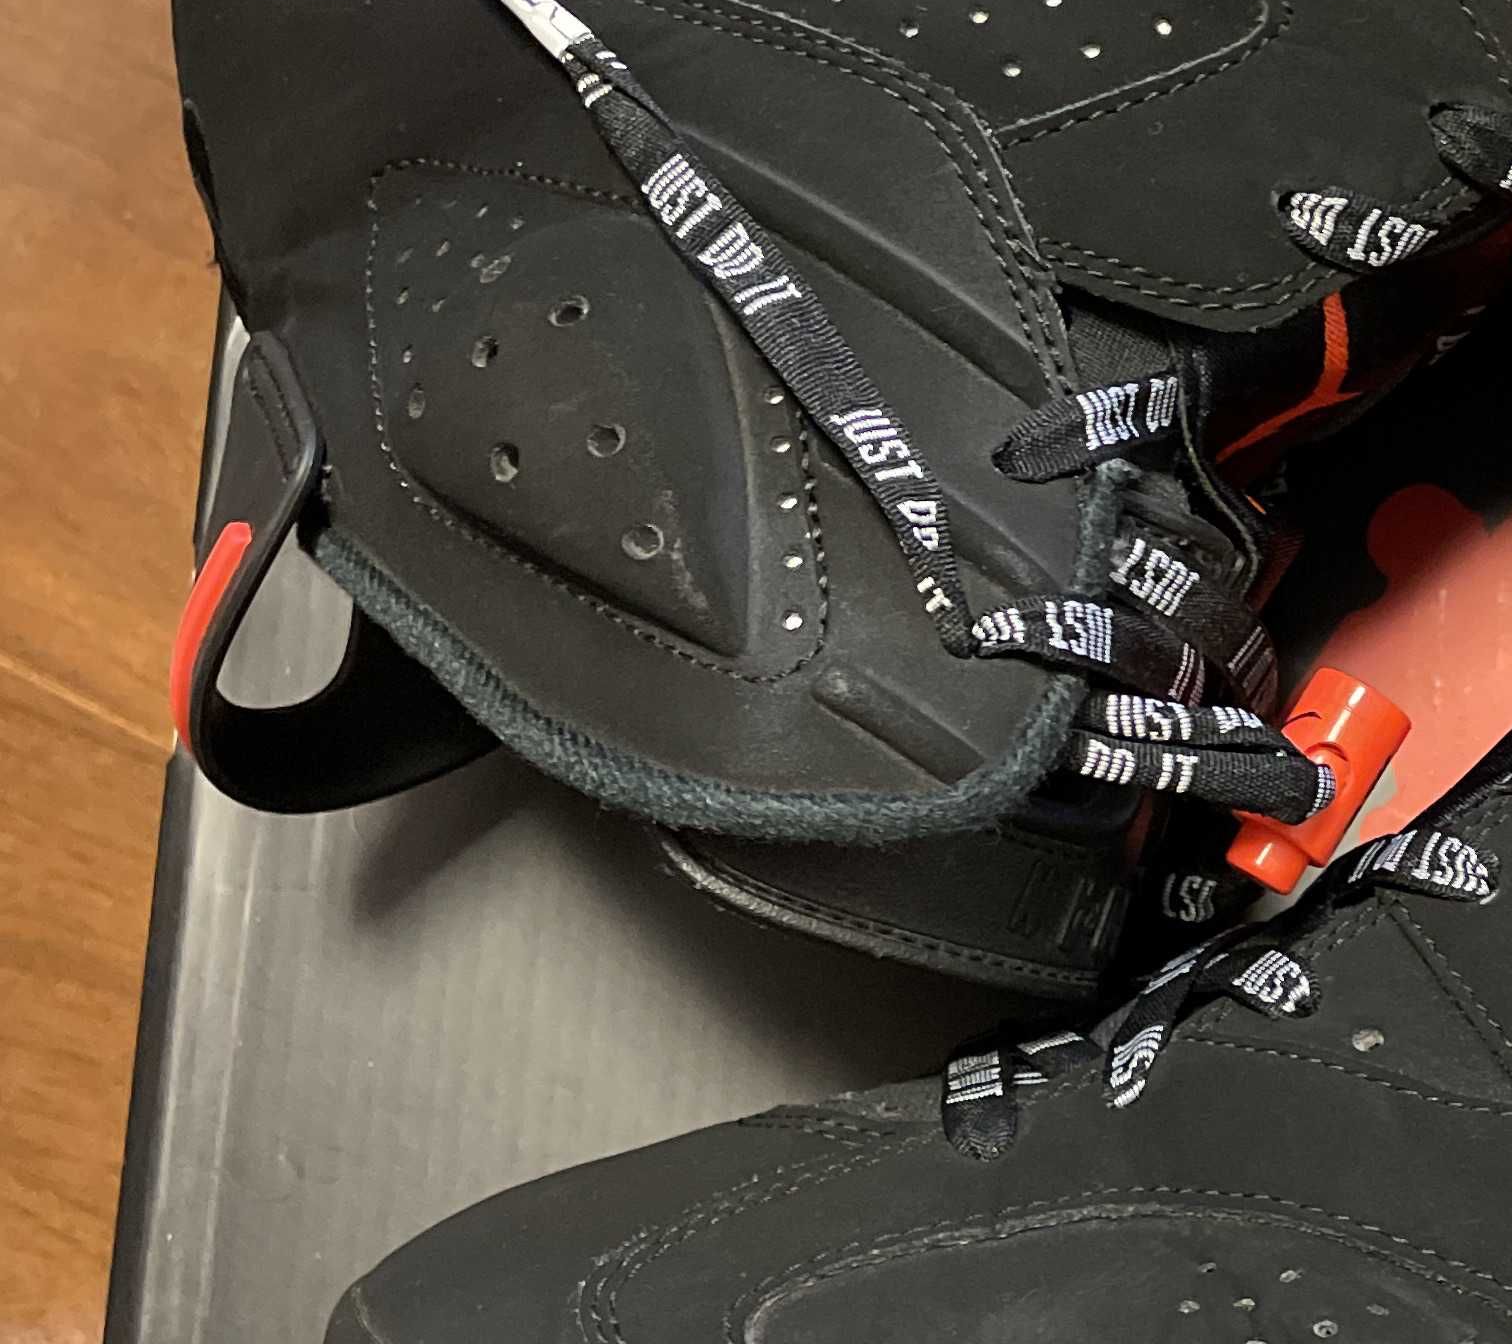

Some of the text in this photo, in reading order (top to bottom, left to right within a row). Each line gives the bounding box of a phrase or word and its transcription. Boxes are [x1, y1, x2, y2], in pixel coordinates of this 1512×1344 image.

[641, 153, 802, 315] JUST DO IT
[830, 408, 924, 482] JUST
[1109, 538, 1200, 616] JUST
[1045, 600, 1114, 664] JUST
[1106, 694, 1195, 742] JUST
[1080, 738, 1200, 793] DO IT
